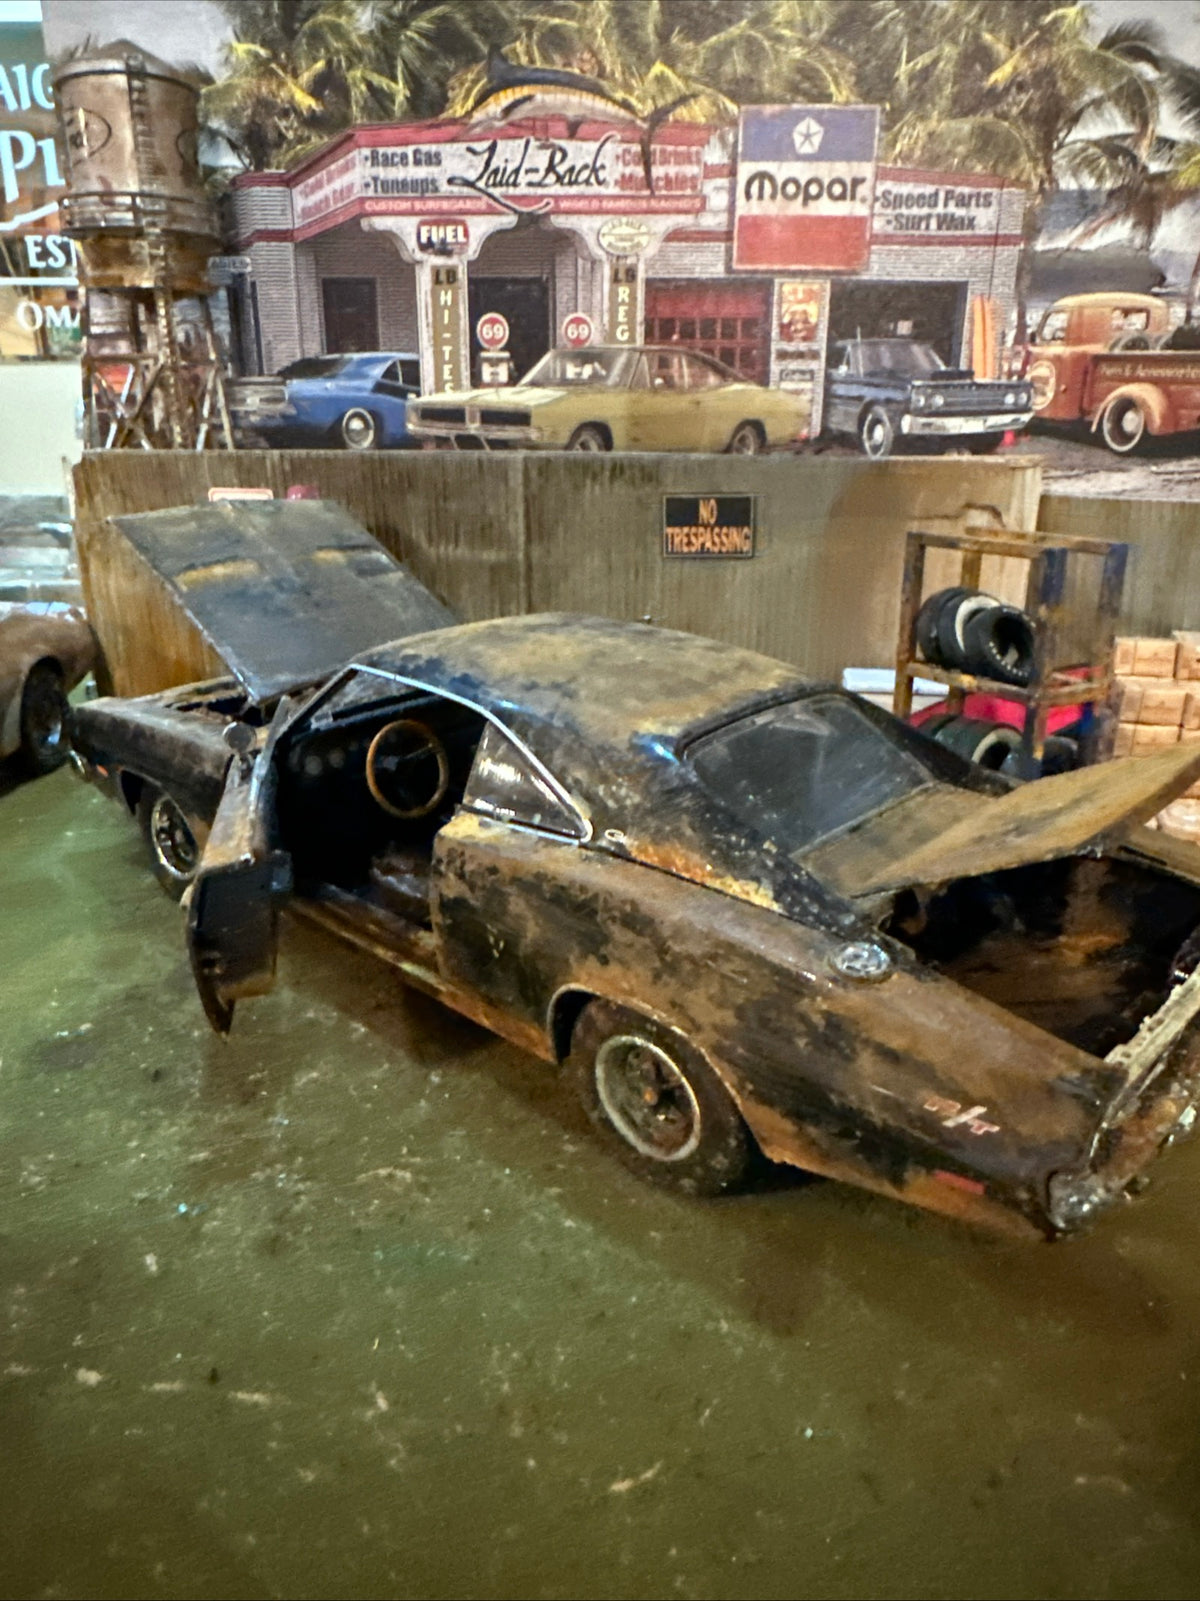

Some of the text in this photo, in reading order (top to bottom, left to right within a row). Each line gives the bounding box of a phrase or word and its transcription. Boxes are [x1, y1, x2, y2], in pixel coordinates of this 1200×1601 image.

[370, 147, 442, 168] Race Gas
[371, 175, 440, 197] Tuneups
[881, 188, 993, 210] Speed Parts
[892, 212, 977, 232] Surf Wax
[419, 224, 468, 243] FUEL
[482, 324, 504, 340] 69
[566, 324, 589, 340] 69
[699, 498, 718, 525] NO
[666, 526, 751, 553] TRESPASSING
